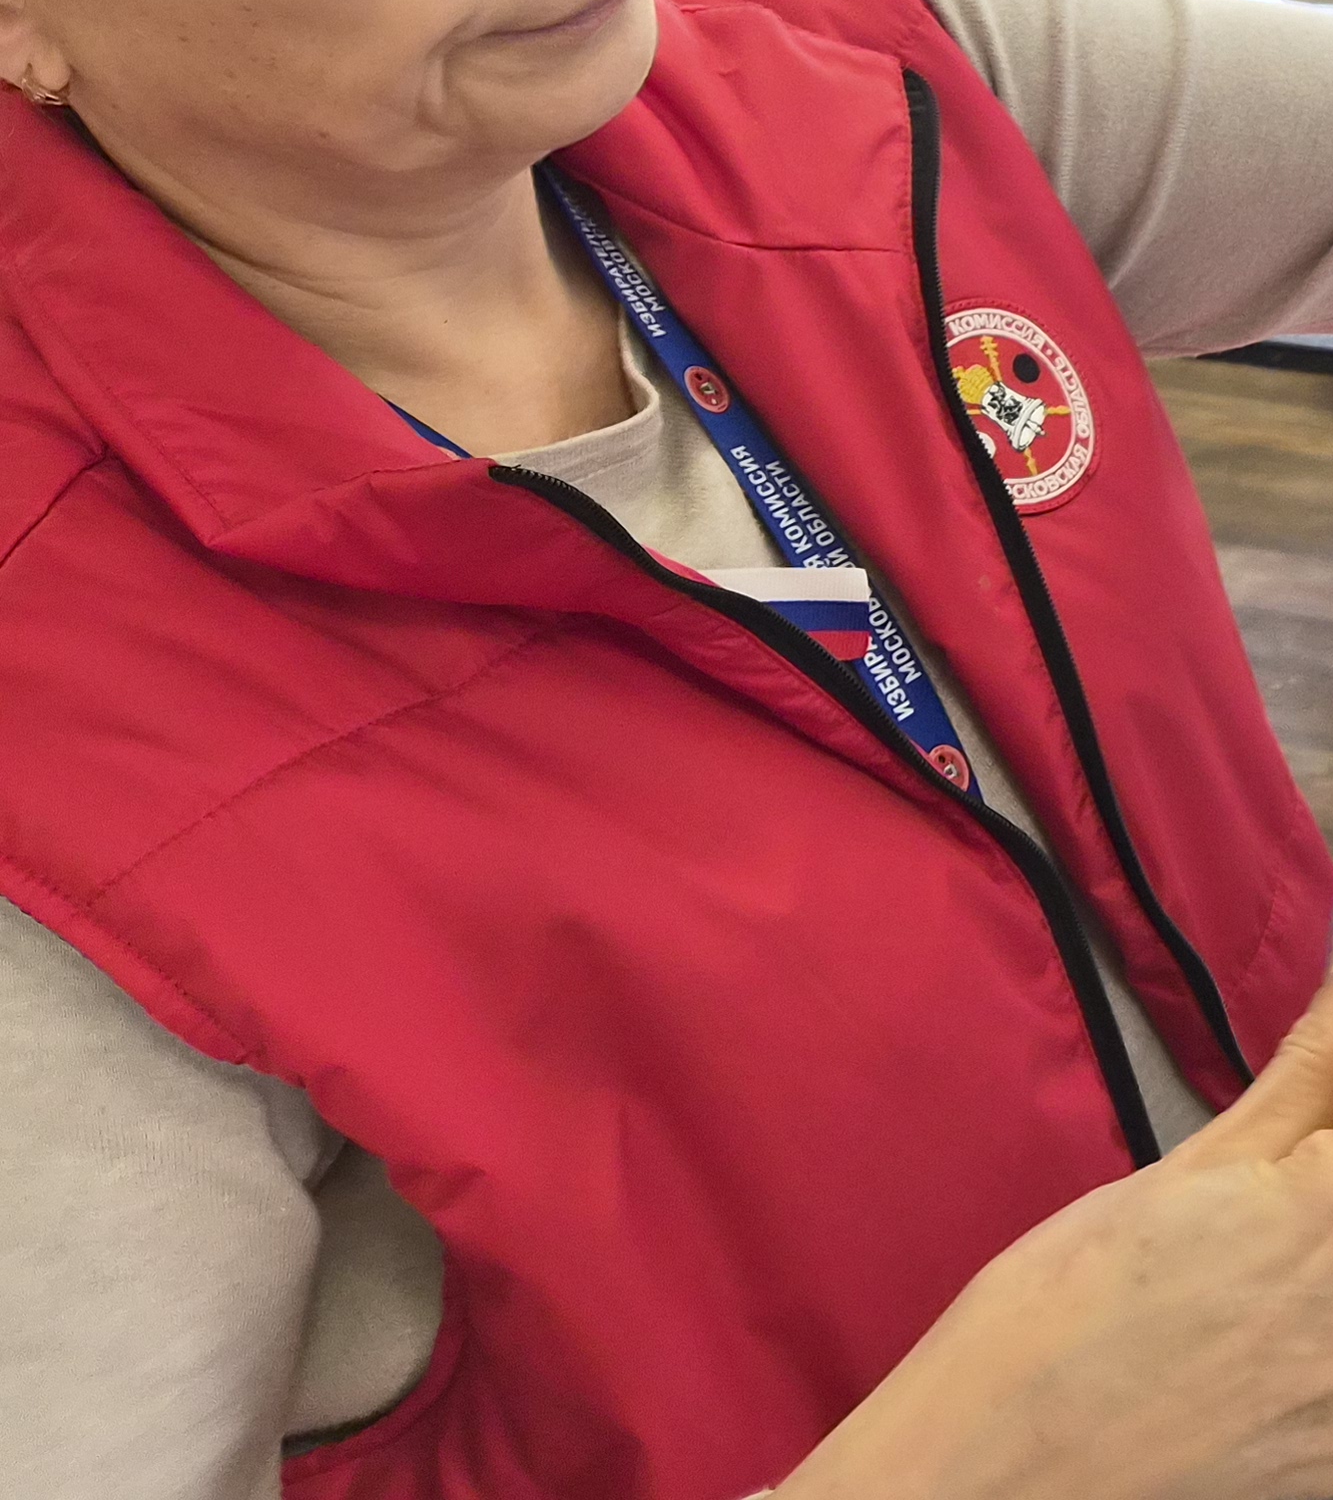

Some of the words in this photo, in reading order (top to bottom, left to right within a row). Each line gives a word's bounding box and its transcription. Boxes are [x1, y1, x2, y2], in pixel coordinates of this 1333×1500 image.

[1005, 443, 1088, 499] СКОВСКАЯ
[1053, 353, 1090, 439] ОБЛАСТЬ
[730, 445, 813, 554] КОМИССИЯ
[765, 460, 834, 547] ОБЛАСТИ
